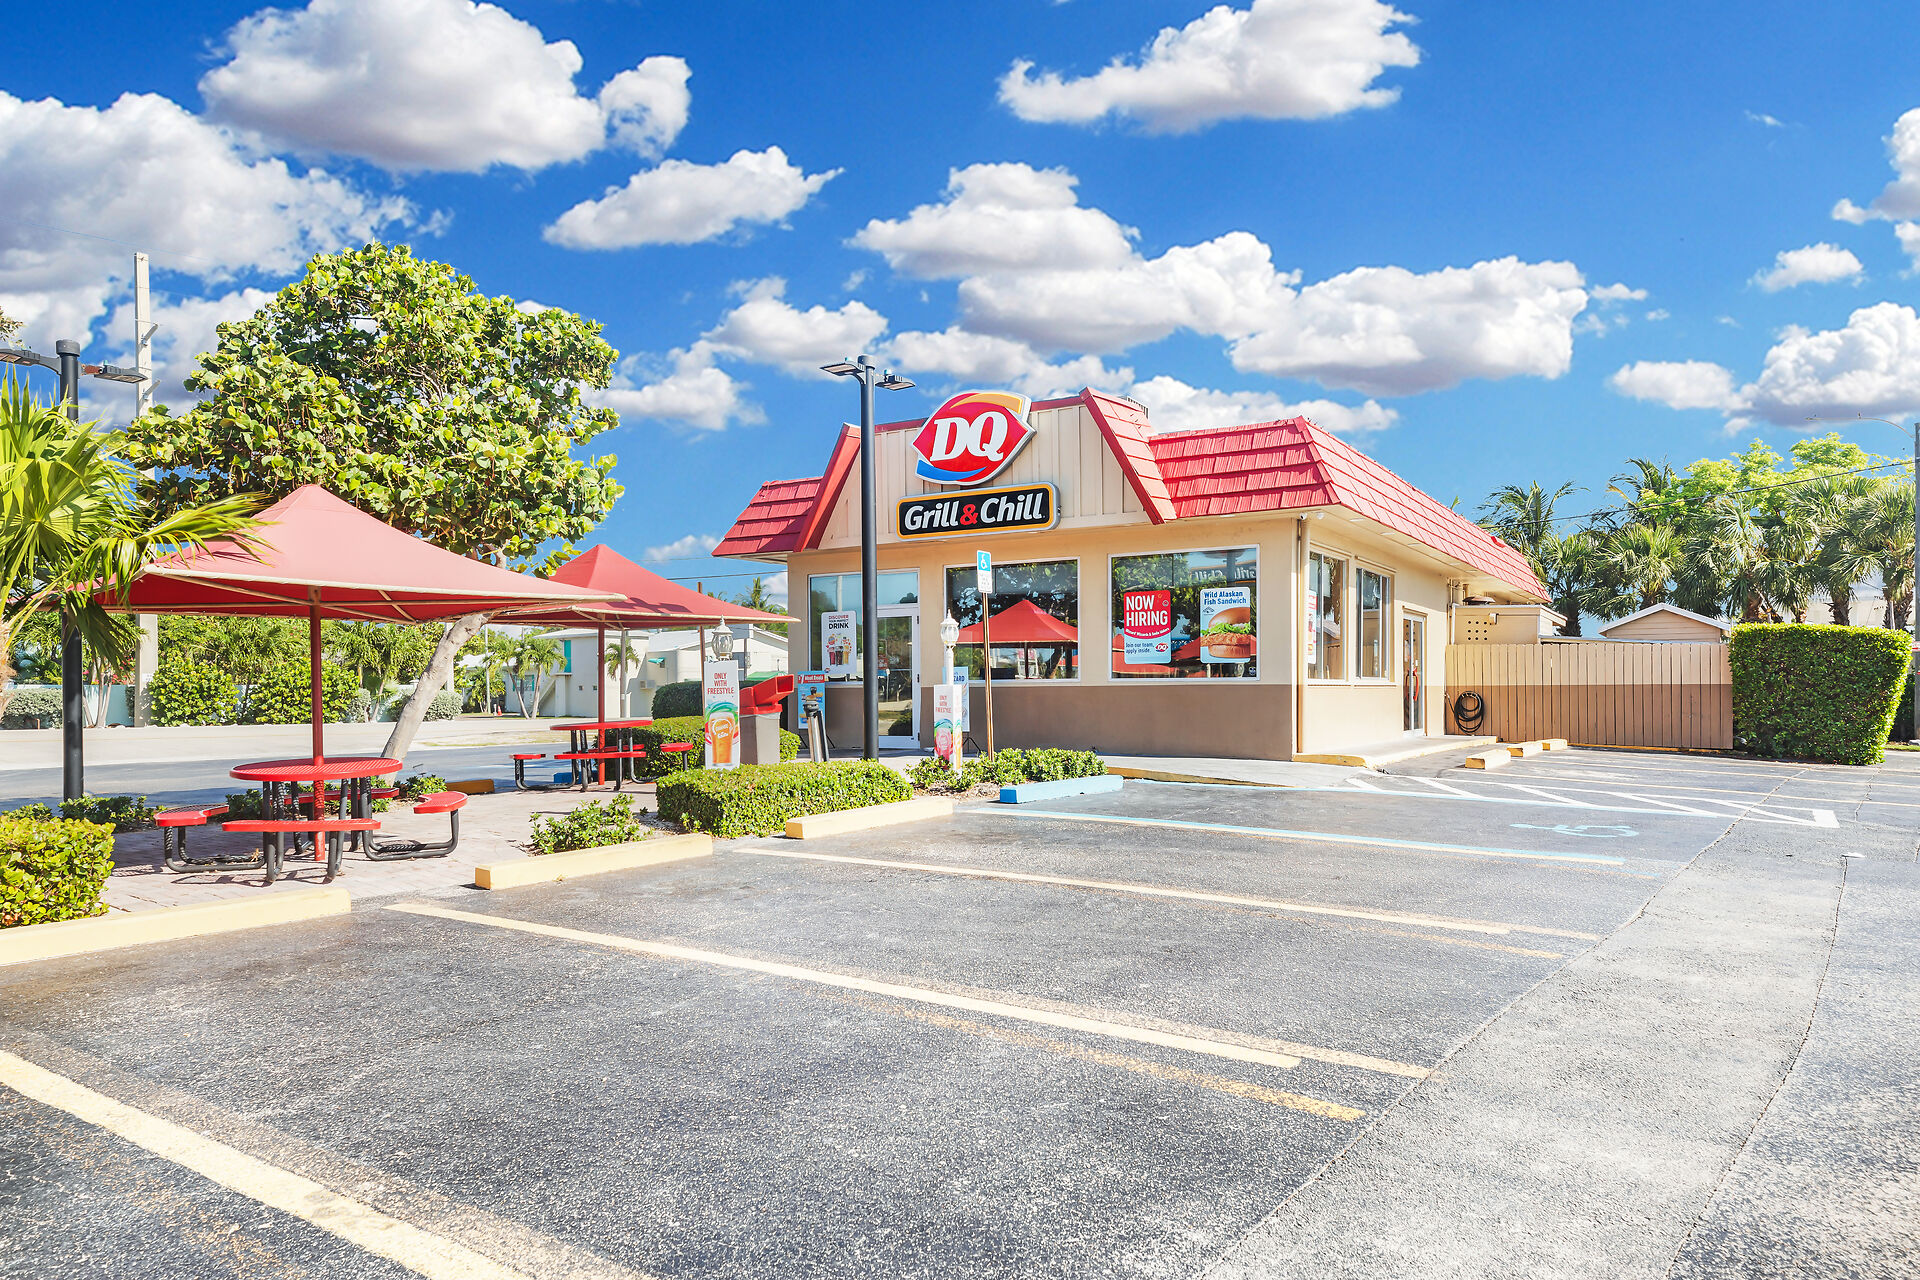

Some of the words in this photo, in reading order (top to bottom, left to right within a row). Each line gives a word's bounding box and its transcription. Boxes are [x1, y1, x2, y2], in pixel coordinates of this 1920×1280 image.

[929, 411, 1008, 462] DQ
[1126, 594, 1155, 611] NOW
[1217, 597, 1247, 605] Sandwich
[828, 622, 849, 630] DRINK
[1126, 610, 1168, 626] HIRING
